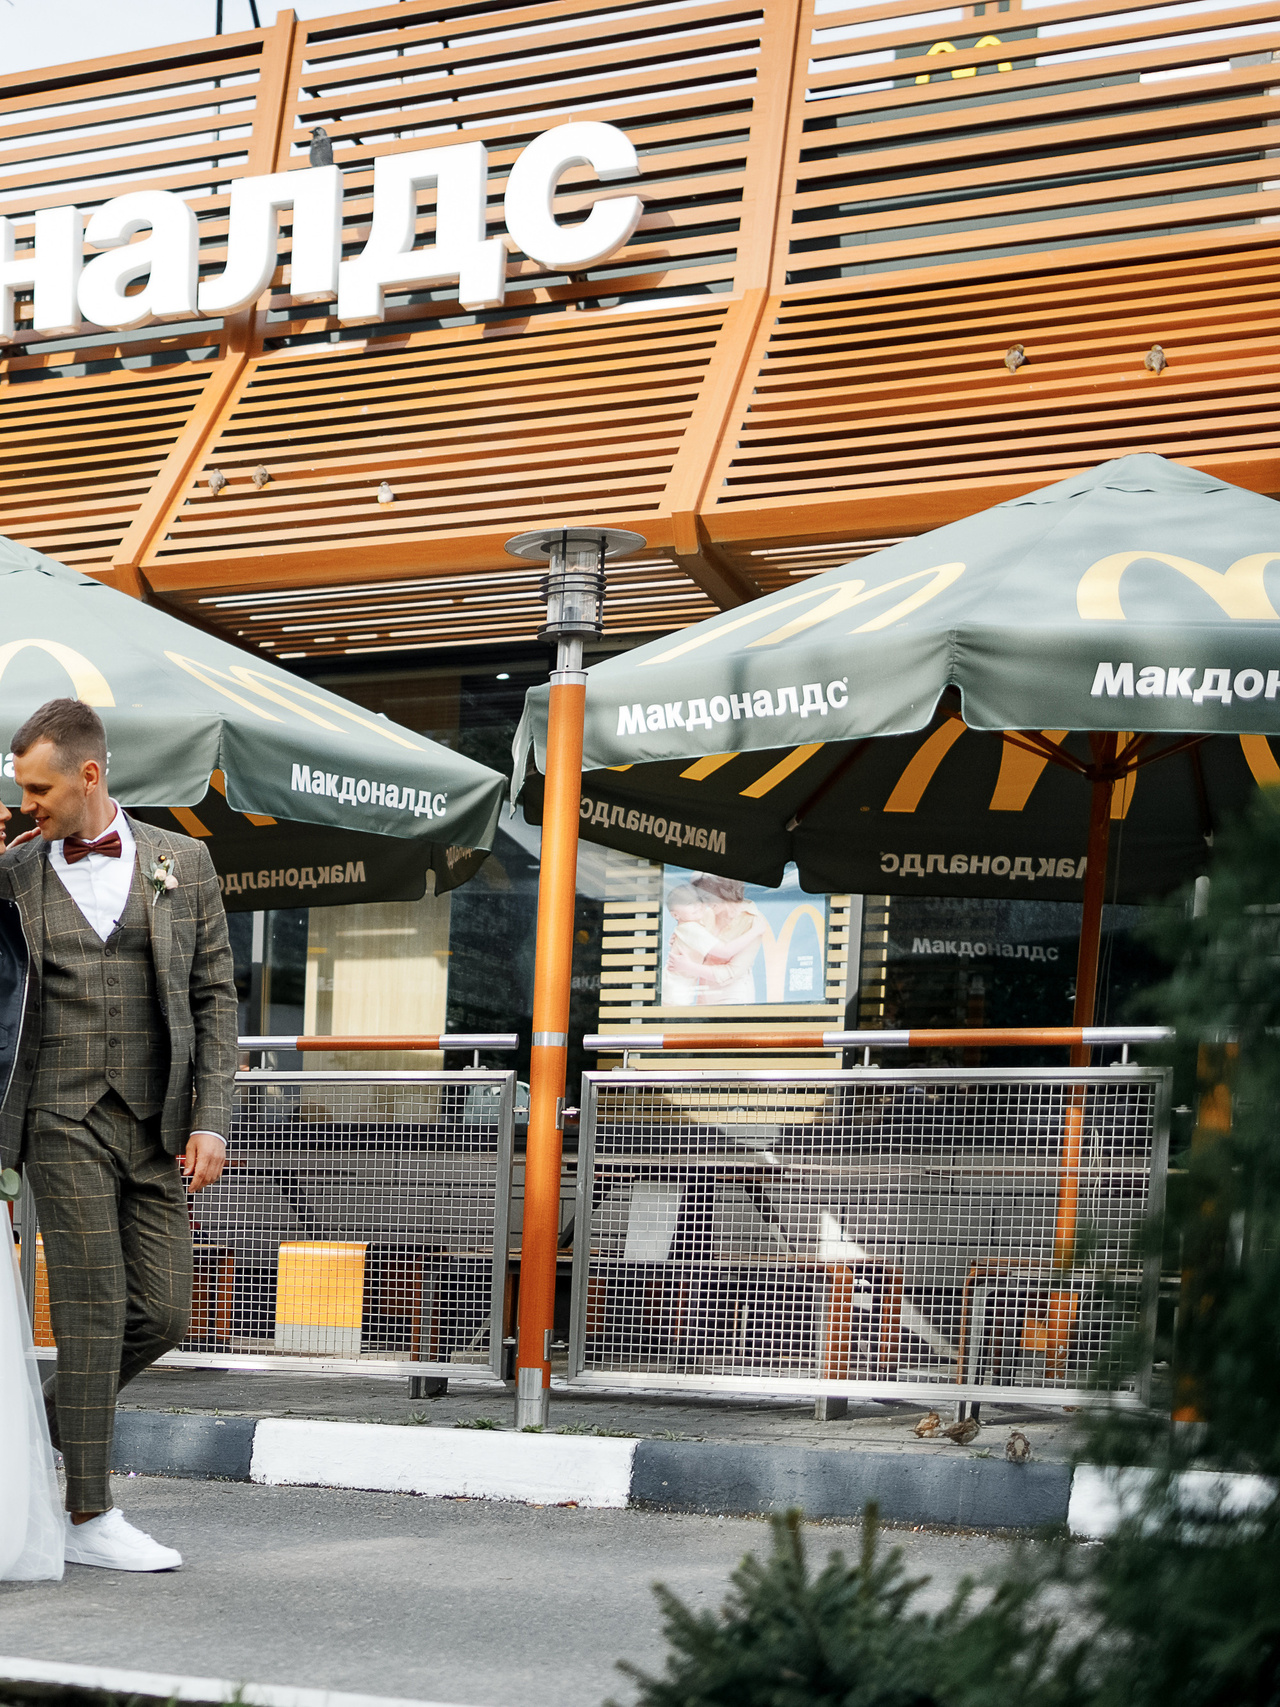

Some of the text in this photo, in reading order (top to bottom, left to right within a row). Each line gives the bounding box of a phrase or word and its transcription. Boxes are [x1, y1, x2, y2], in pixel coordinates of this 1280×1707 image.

[616, 679, 849, 736] Макдоналдс
[290, 763, 448, 819] Макдоналдс
[912, 937, 1059, 962] Макдоналдс
